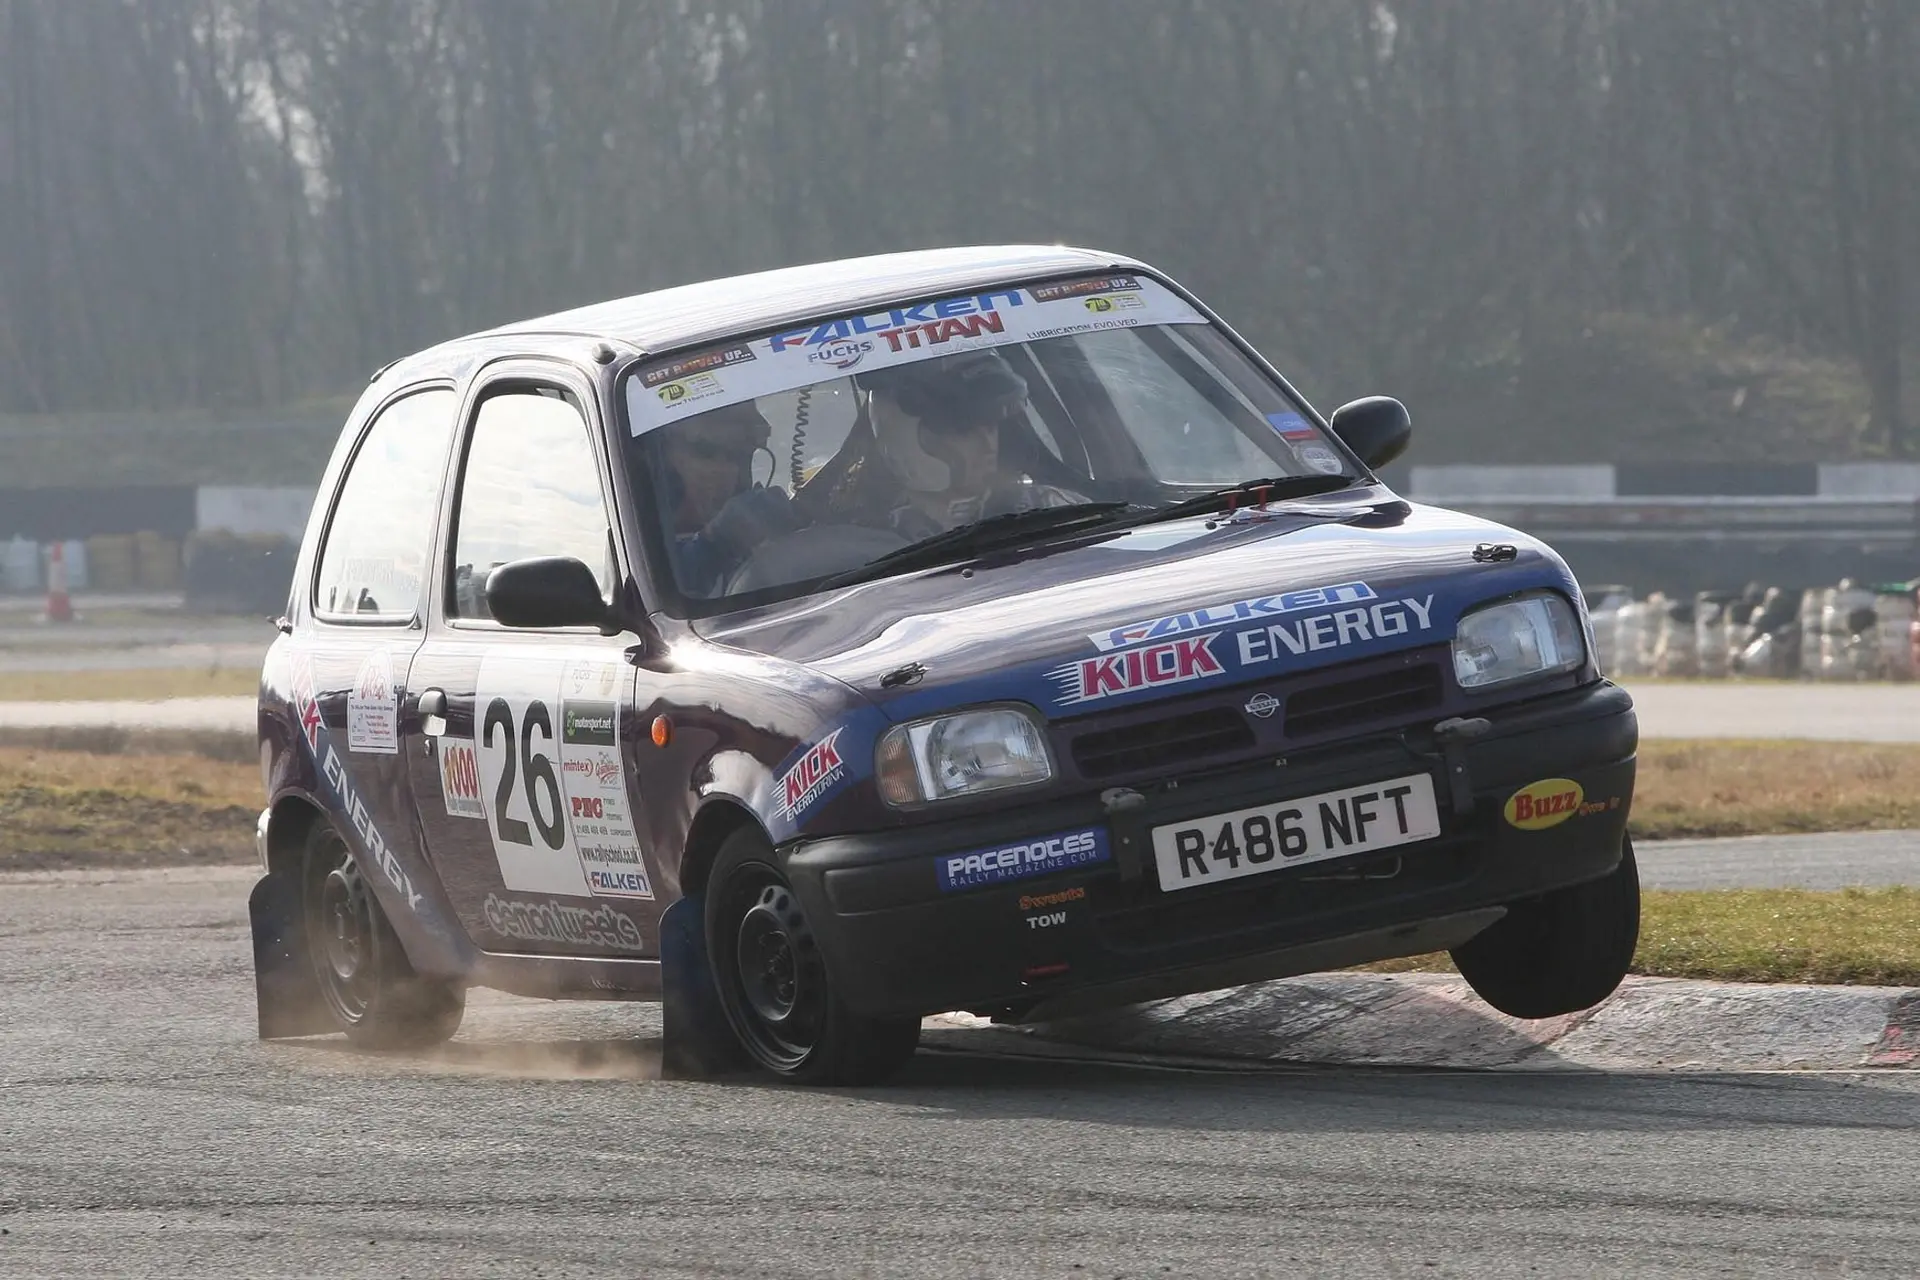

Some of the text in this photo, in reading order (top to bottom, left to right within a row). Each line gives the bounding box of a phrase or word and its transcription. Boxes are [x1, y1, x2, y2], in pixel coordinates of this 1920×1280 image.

[766, 289, 1024, 353] FALKEN
[1026, 317, 1139, 340] LUBRICATION EVOLVED
[807, 339, 875, 364] FUCHS
[1102, 582, 1372, 647] FALKEN
[1079, 594, 1434, 699] KICK ENERGY
[482, 696, 566, 851] 26
[563, 758, 590, 773] mintex
[783, 729, 844, 809] KICK
[322, 744, 424, 911] ENERGY
[1514, 790, 1578, 822] Buzz
[947, 831, 1097, 878] PACENOTES
[1175, 785, 1412, 879] R486 NFT
[590, 870, 649, 893] FALKEN
[950, 872, 990, 888] RALLY
[1026, 911, 1067, 930] TOW
